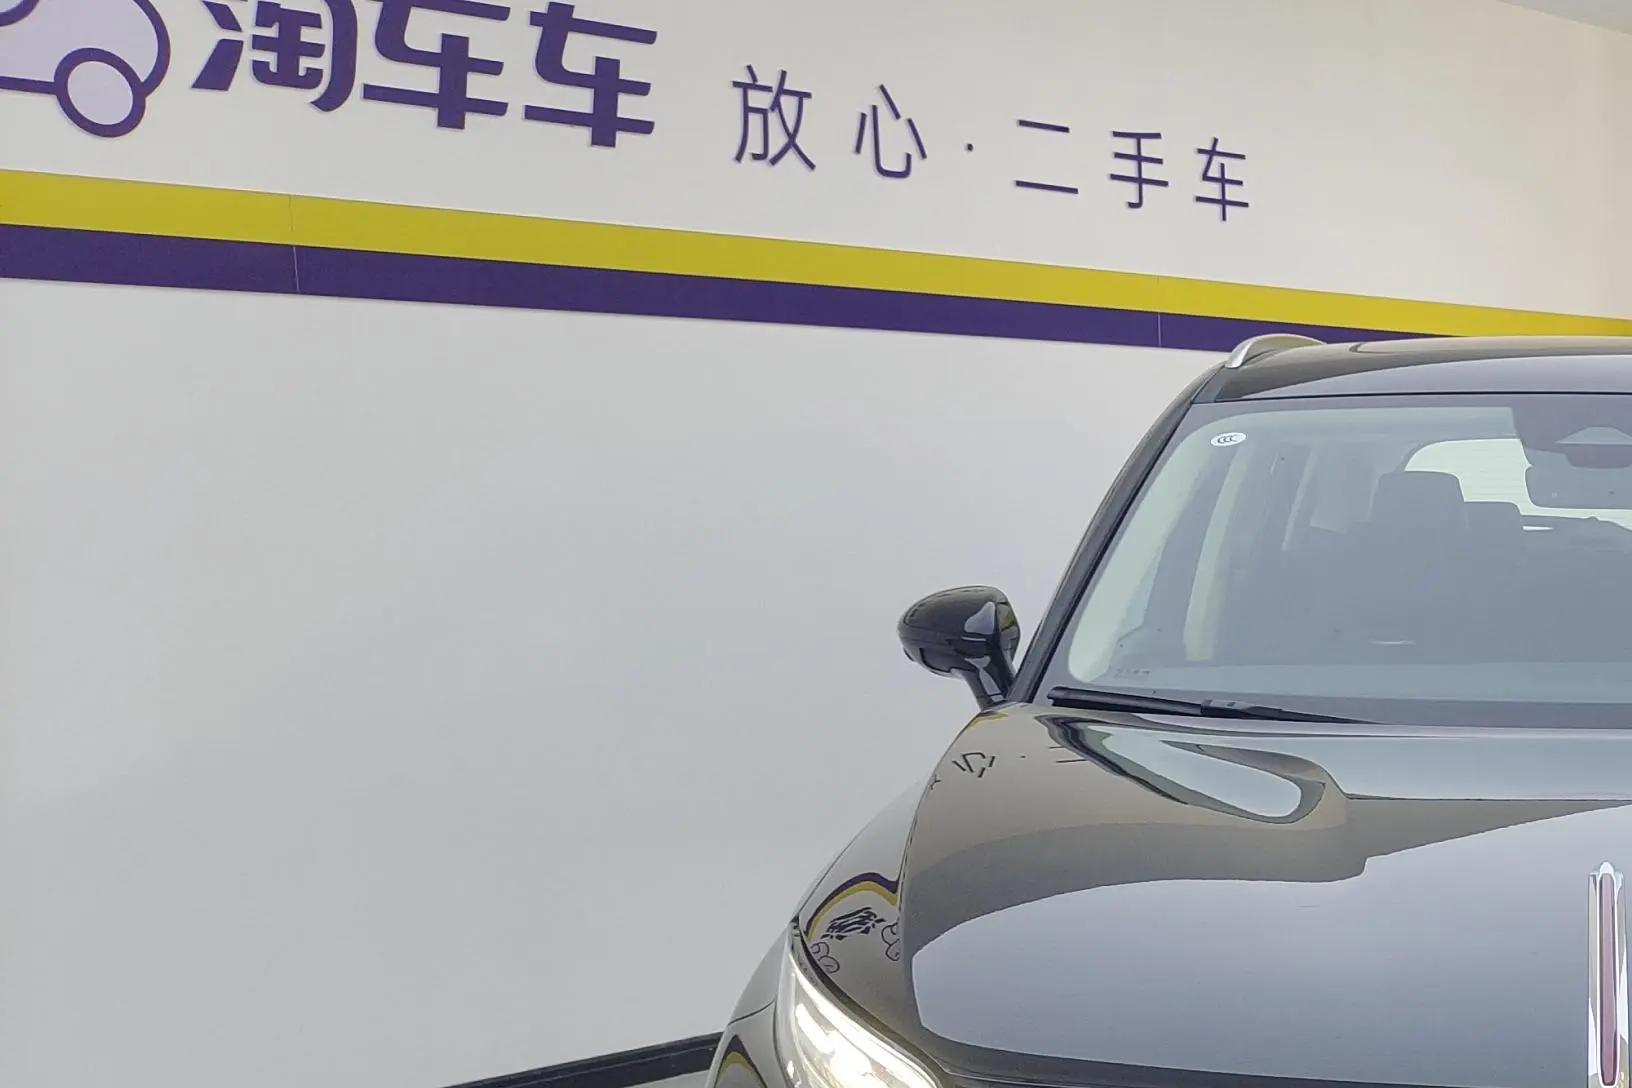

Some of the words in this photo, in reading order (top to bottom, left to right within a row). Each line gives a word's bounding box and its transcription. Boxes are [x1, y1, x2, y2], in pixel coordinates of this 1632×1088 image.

[191, 0, 657, 147] 淘车车
[732, 64, 1249, 222] 放心·二手车
